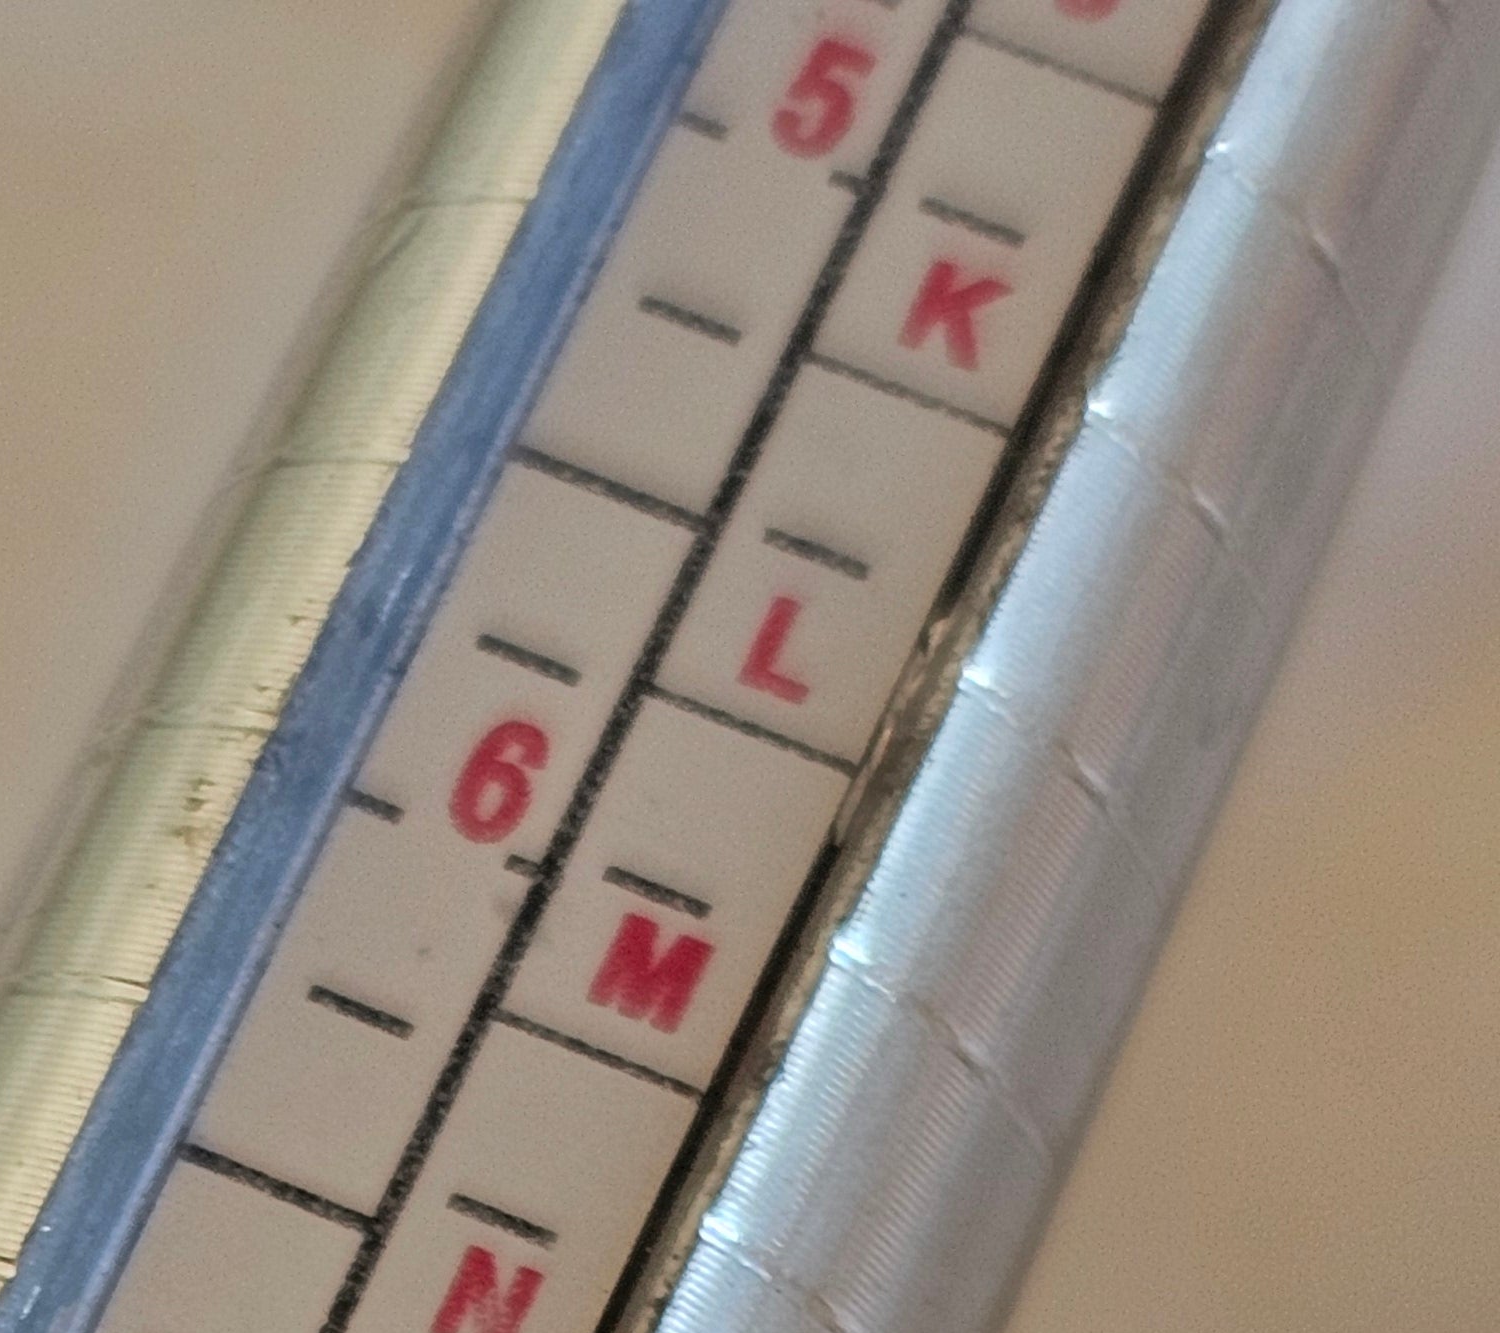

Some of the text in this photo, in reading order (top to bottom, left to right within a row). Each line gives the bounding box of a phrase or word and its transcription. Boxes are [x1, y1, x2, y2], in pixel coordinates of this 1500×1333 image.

[771, 38, 877, 160] 5
[898, 255, 1012, 371] K
[739, 592, 808, 700] L
[451, 720, 549, 840] 6
[587, 912, 714, 1031] M
